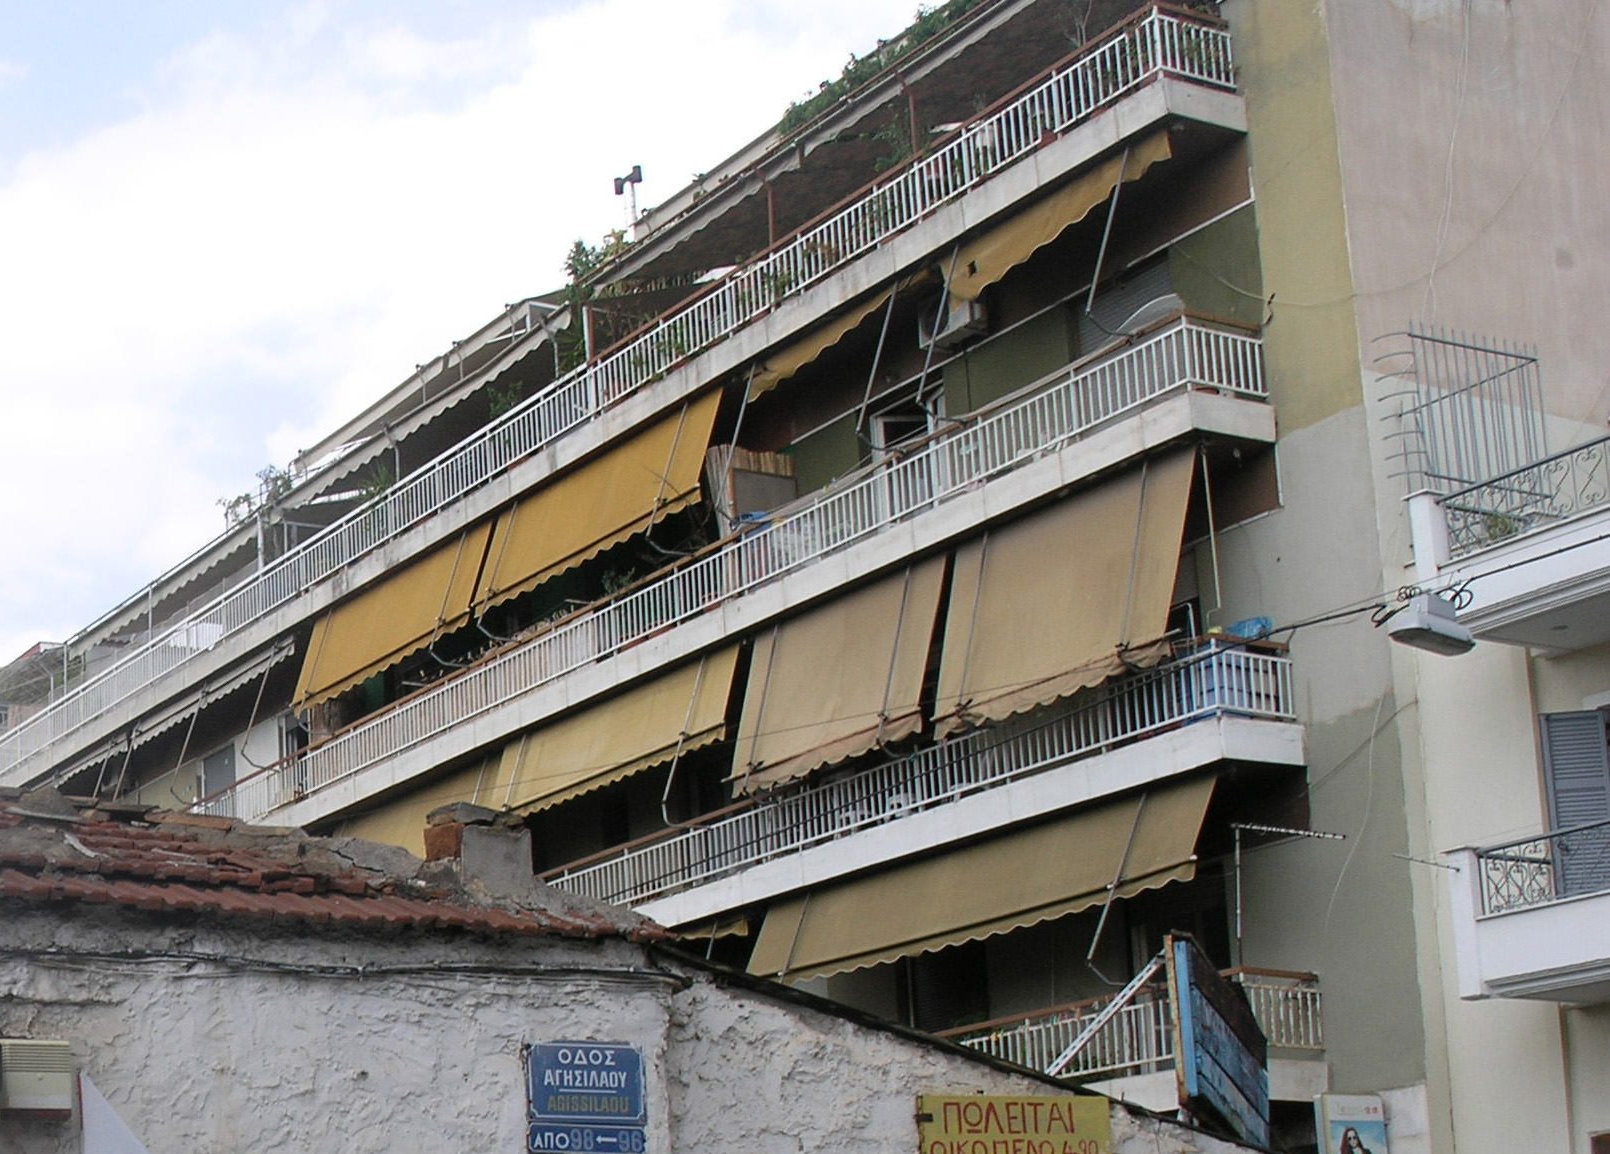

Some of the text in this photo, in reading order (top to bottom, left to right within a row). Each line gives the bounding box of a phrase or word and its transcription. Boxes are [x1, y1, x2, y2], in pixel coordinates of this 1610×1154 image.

[558, 1049, 616, 1066] ΟΔΟΣ
[544, 1069, 627, 1088] ΑΓΗΣΙΛΑΟΥ
[547, 1095, 629, 1113] AGISSILAOU
[942, 1101, 1076, 1135] ΠΩΛΕΙΤΑΙ
[533, 1132, 570, 1149] ΑΠΟ
